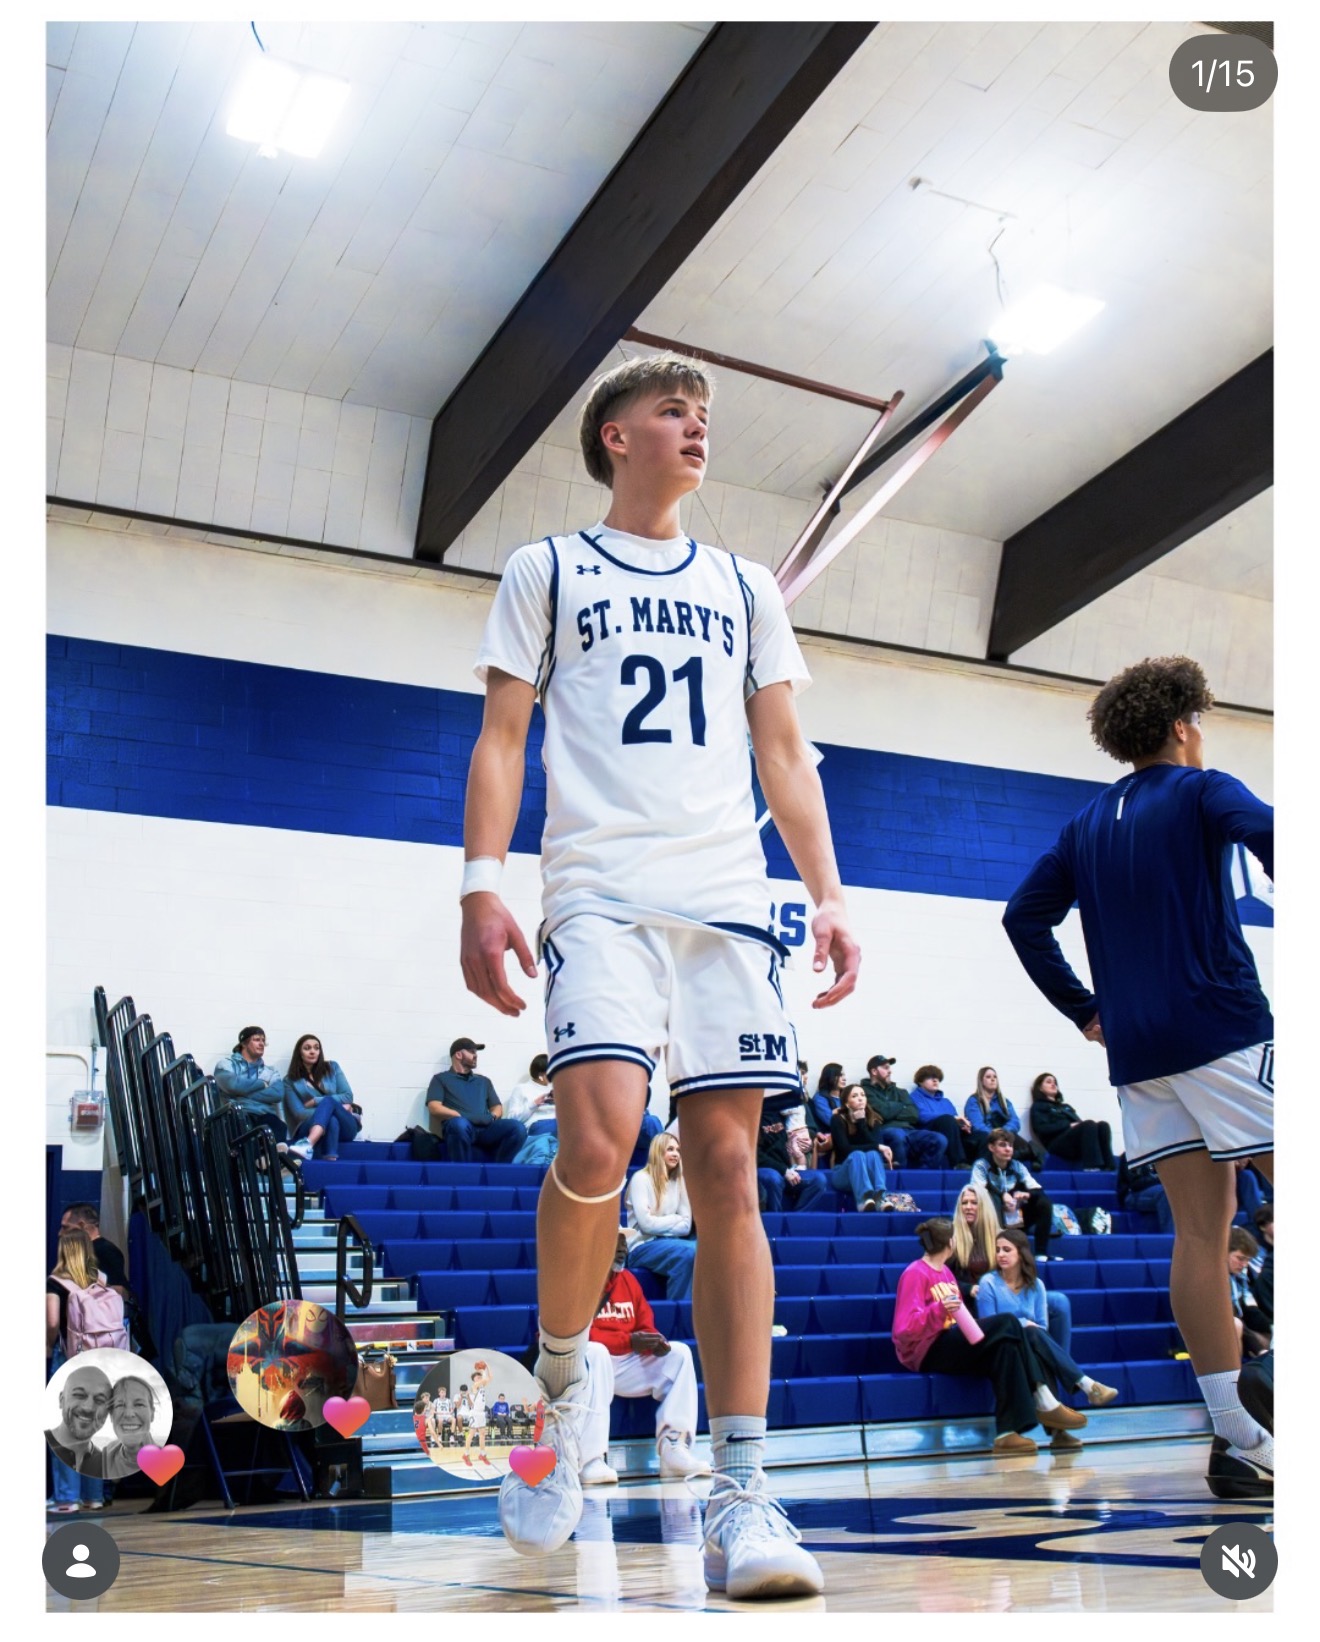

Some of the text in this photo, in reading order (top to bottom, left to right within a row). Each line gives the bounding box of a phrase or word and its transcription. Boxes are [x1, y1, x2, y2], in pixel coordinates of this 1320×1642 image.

[577, 597, 734, 657] ST. MARY'S
[620, 654, 706, 746] 21
